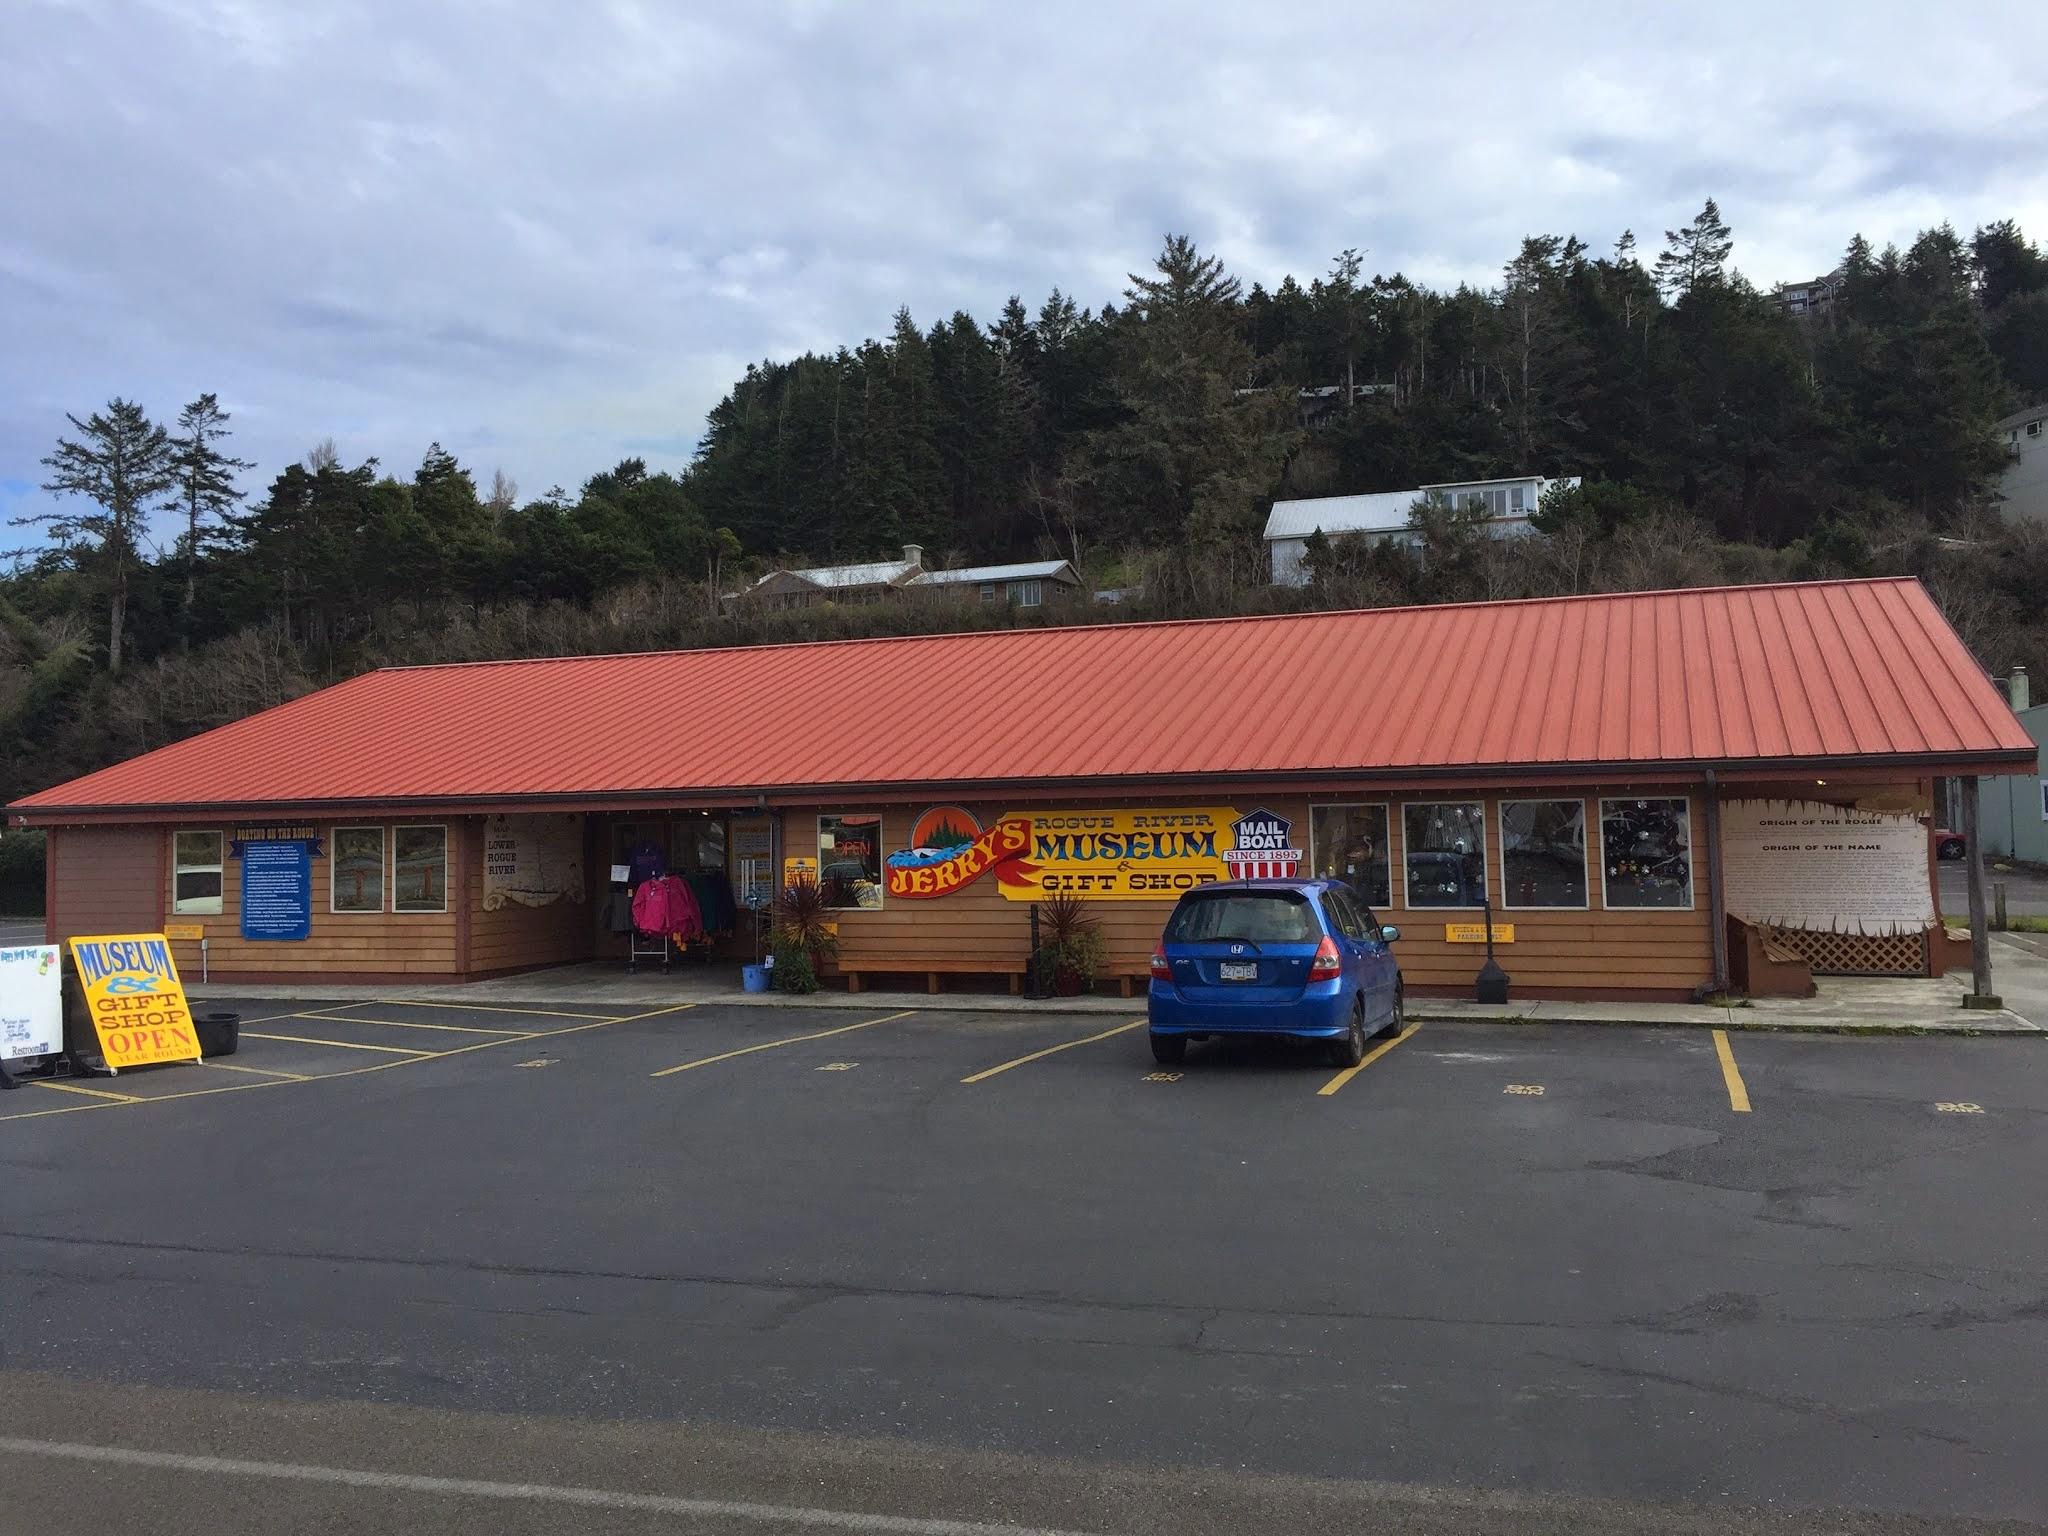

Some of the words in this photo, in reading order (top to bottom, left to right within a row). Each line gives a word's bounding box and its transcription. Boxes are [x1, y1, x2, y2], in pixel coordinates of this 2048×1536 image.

[1035, 817, 1114, 829] ROGUE
[1133, 815, 1213, 827] RIVER
[1240, 821, 1283, 835] MAIL
[488, 841, 516, 849] LOWER
[1034, 831, 1218, 861] MUSEUM
[1240, 835, 1285, 849] BOAT
[488, 853, 517, 862] ROGUE
[891, 823, 1025, 893] JERRY'S
[1227, 852, 1265, 860] SINCE
[1270, 851, 1298, 859] 1895
[488, 865, 516, 875] RIVER
[1117, 860, 1134, 872] &
[1042, 875, 1116, 890] GIFT
[75, 940, 176, 987] MUSEUM
[106, 977, 160, 994] &
[97, 993, 178, 1012] GIFT
[99, 1011, 186, 1030] SHOP
[108, 1027, 191, 1054] OPEN
[12, 1045, 40, 1057] Restroom
[118, 1054, 148, 1063] YEAR
[154, 1048, 192, 1059] ROUND
